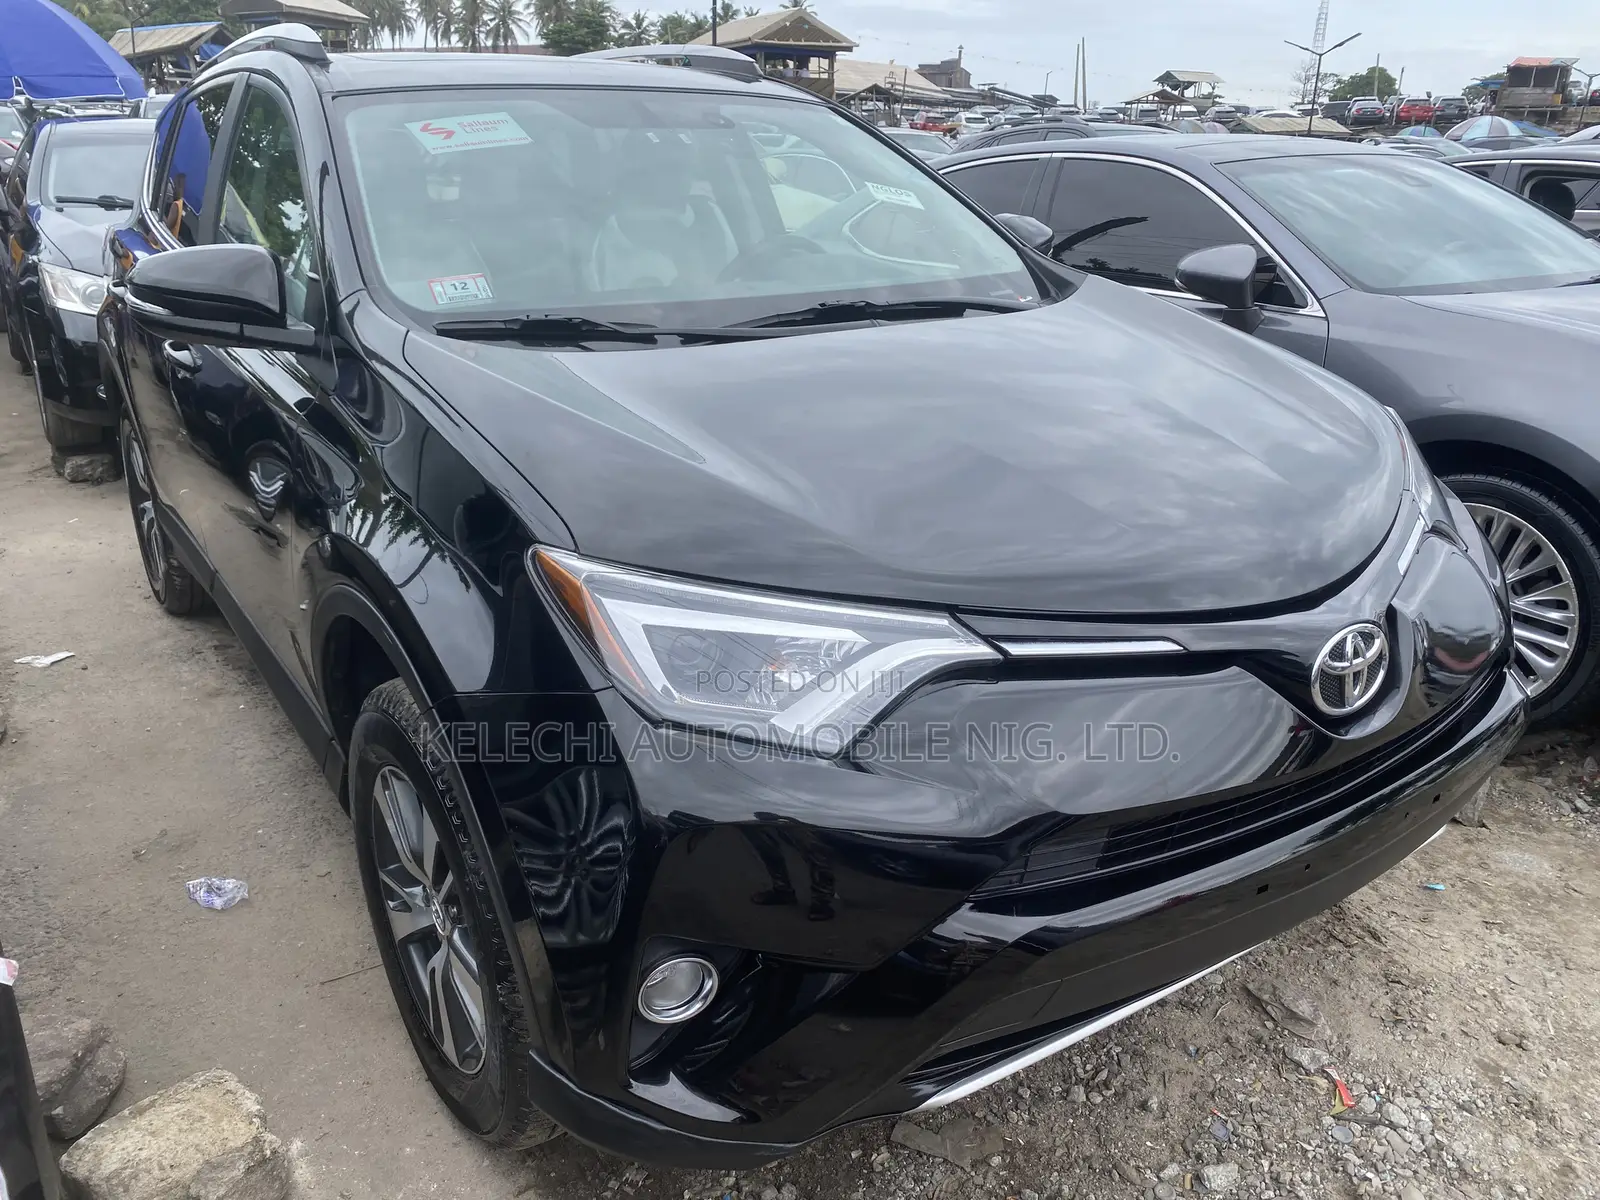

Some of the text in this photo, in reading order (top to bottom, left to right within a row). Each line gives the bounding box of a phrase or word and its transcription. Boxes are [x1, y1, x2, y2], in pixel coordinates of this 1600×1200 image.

[457, 119, 509, 129] Sallaum
[463, 126, 499, 134] Lines
[450, 281, 470, 291] 12
